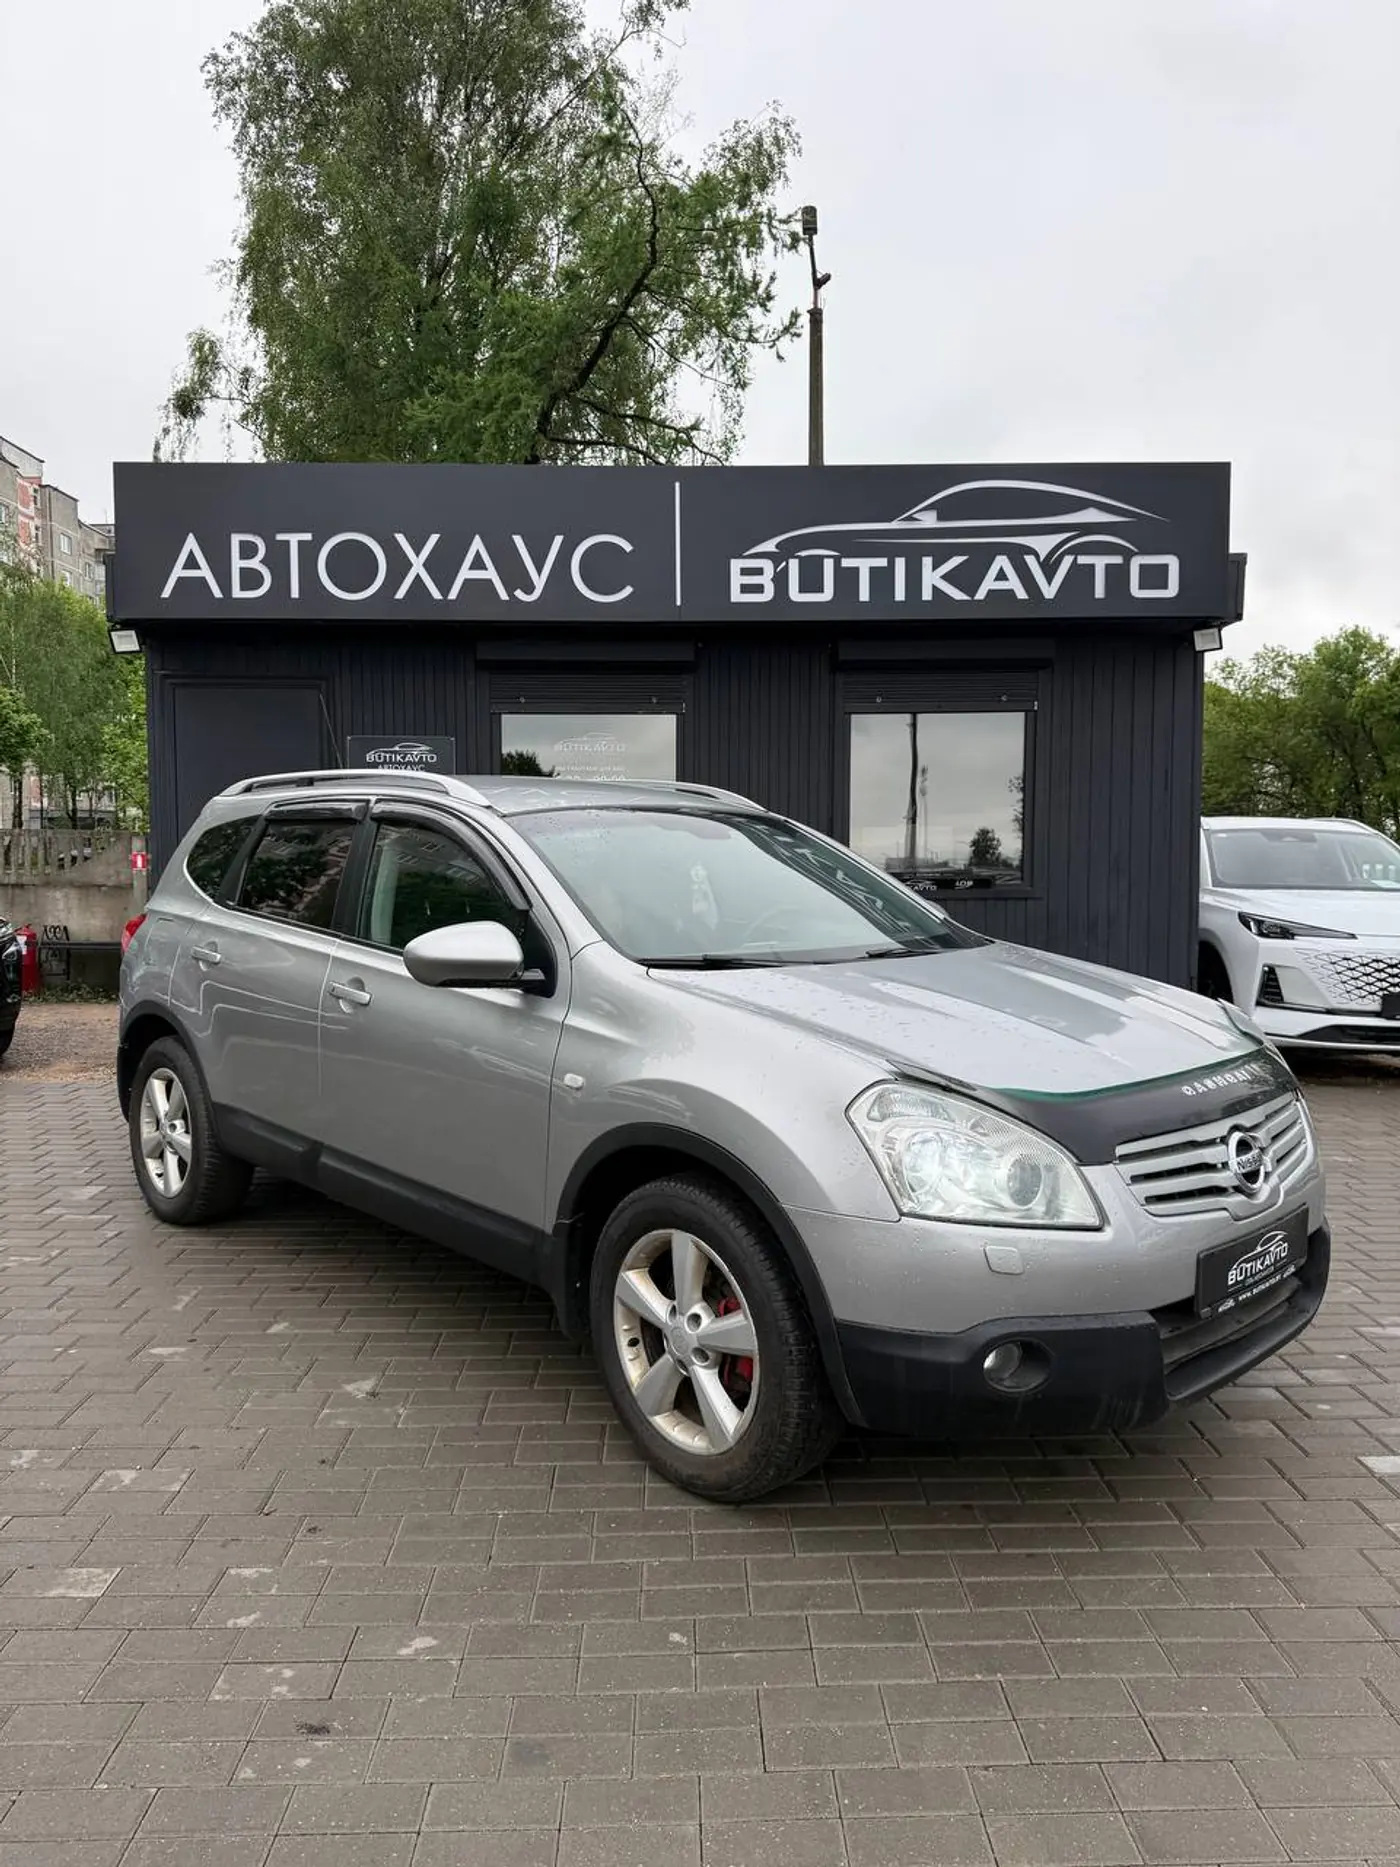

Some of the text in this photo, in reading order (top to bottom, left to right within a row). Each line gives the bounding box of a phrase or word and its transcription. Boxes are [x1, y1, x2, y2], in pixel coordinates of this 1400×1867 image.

[160, 531, 635, 604] АВТОХАУС
[730, 553, 1180, 603] BUTIKAVTO
[366, 752, 437, 763] BUTIKAVTO
[1227, 1242, 1289, 1286] BUTIKAVTO
